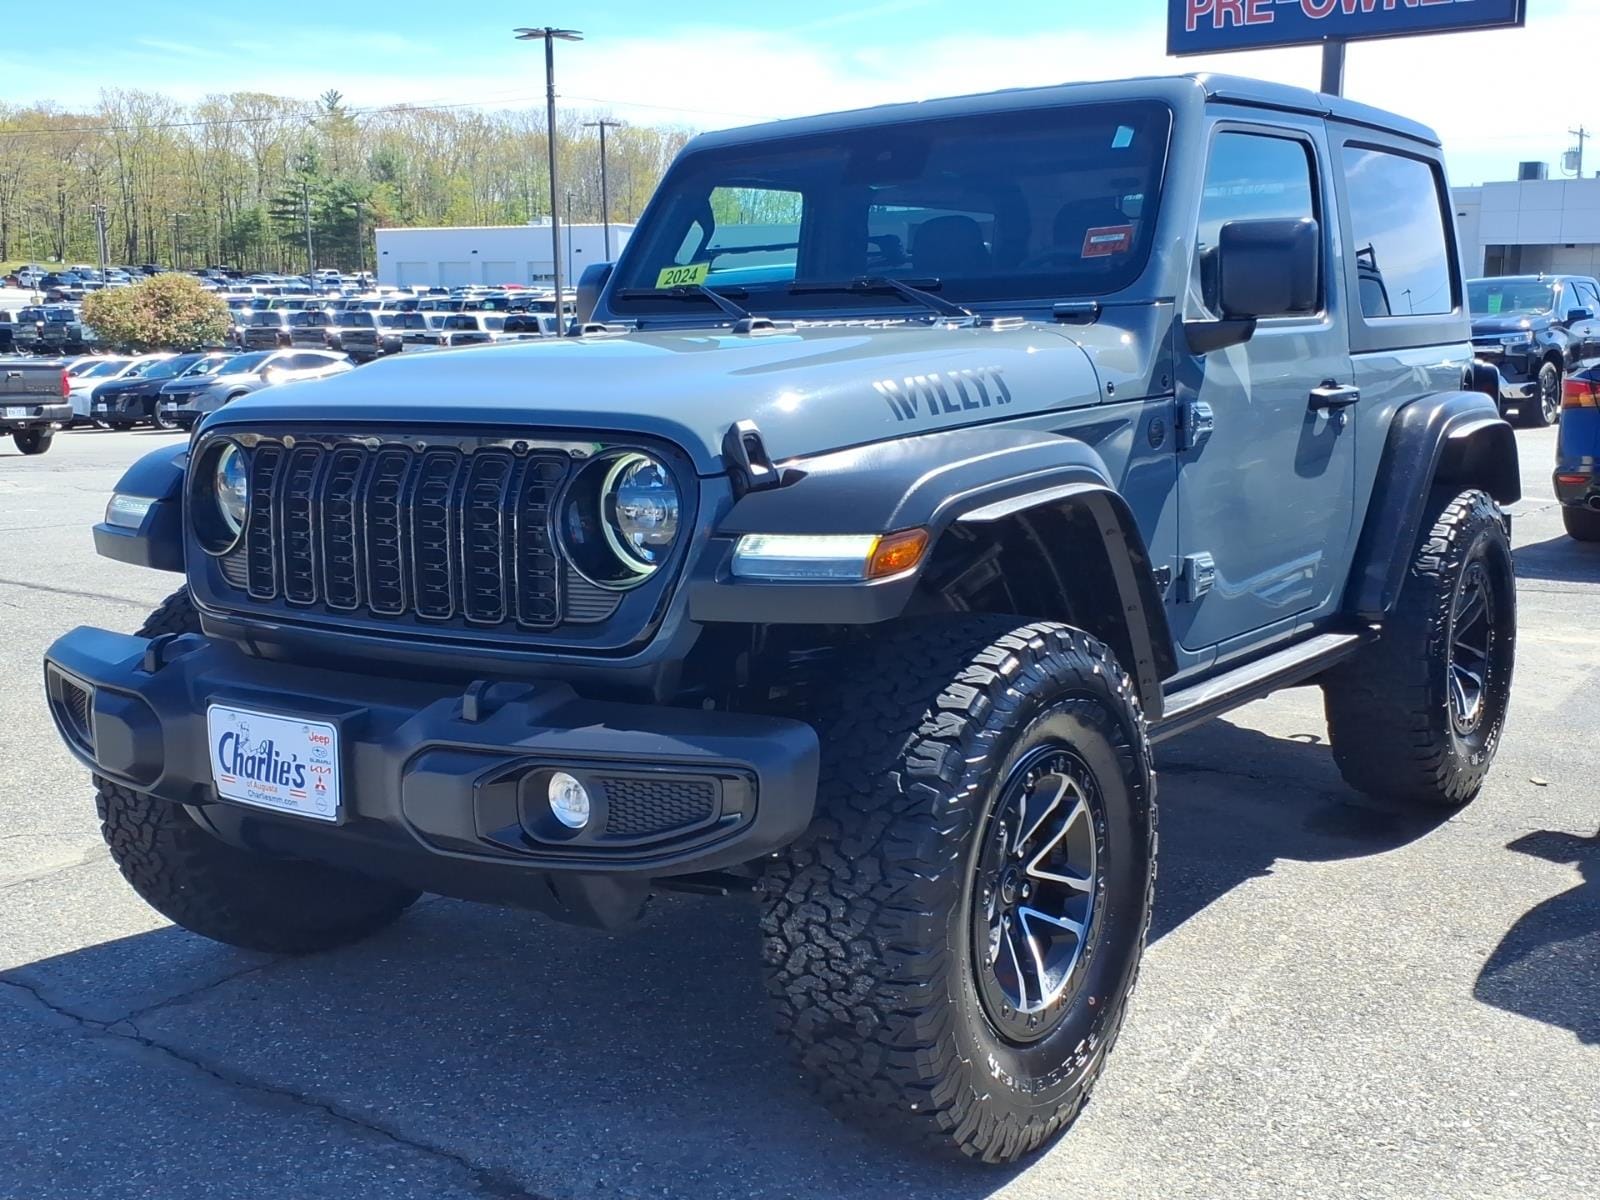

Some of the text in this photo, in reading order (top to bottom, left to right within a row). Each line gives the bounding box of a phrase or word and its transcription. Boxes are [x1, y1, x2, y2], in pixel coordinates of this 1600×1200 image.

[663, 267, 699, 285] 2024
[872, 365, 1012, 421] WILLYS
[308, 732, 330, 745] Jeep
[218, 731, 306, 789] Charlie's
